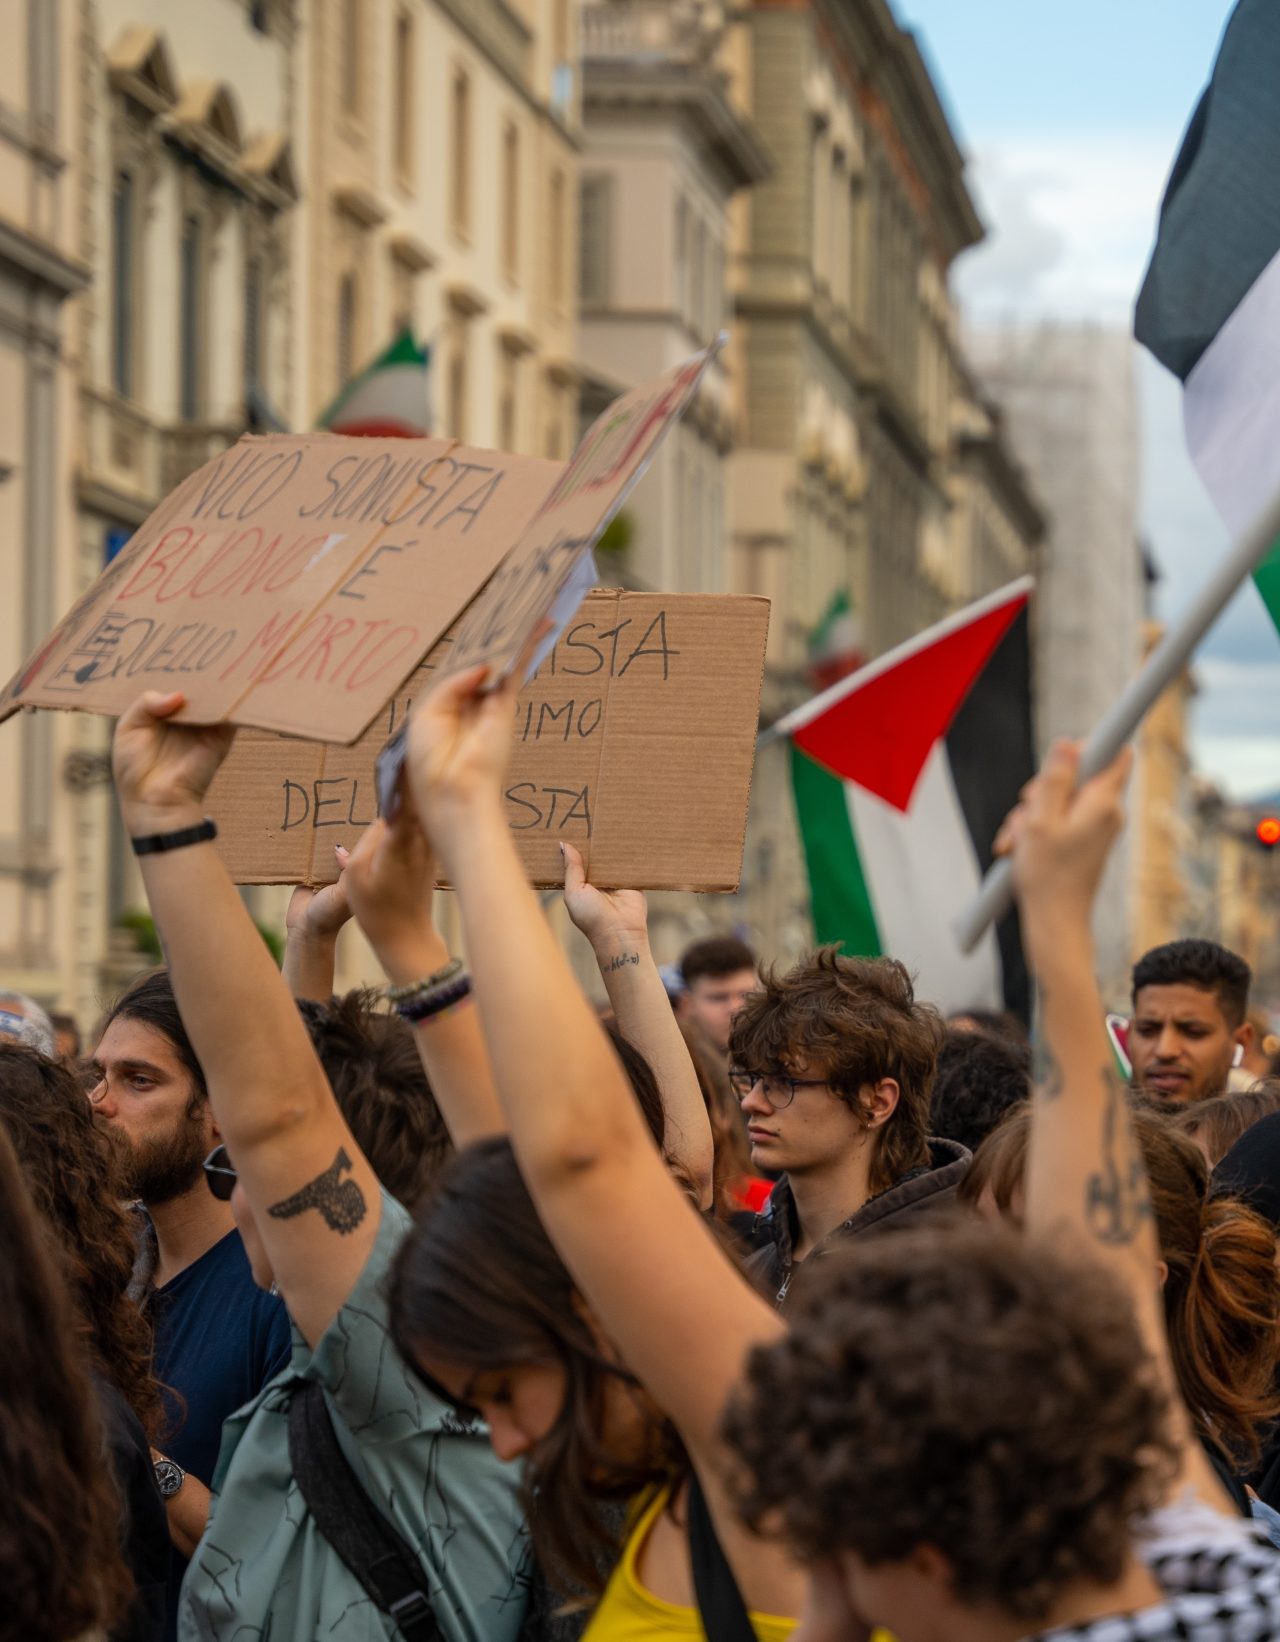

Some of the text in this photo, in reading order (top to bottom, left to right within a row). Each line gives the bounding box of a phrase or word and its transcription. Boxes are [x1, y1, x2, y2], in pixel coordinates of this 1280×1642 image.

[298, 452, 505, 535] SIONISTA
[116, 526, 330, 603] BUONO
[82, 608, 419, 692] QUELLO MORTO
[531, 610, 681, 681] ISTA
[280, 776, 593, 840] DEL STA
